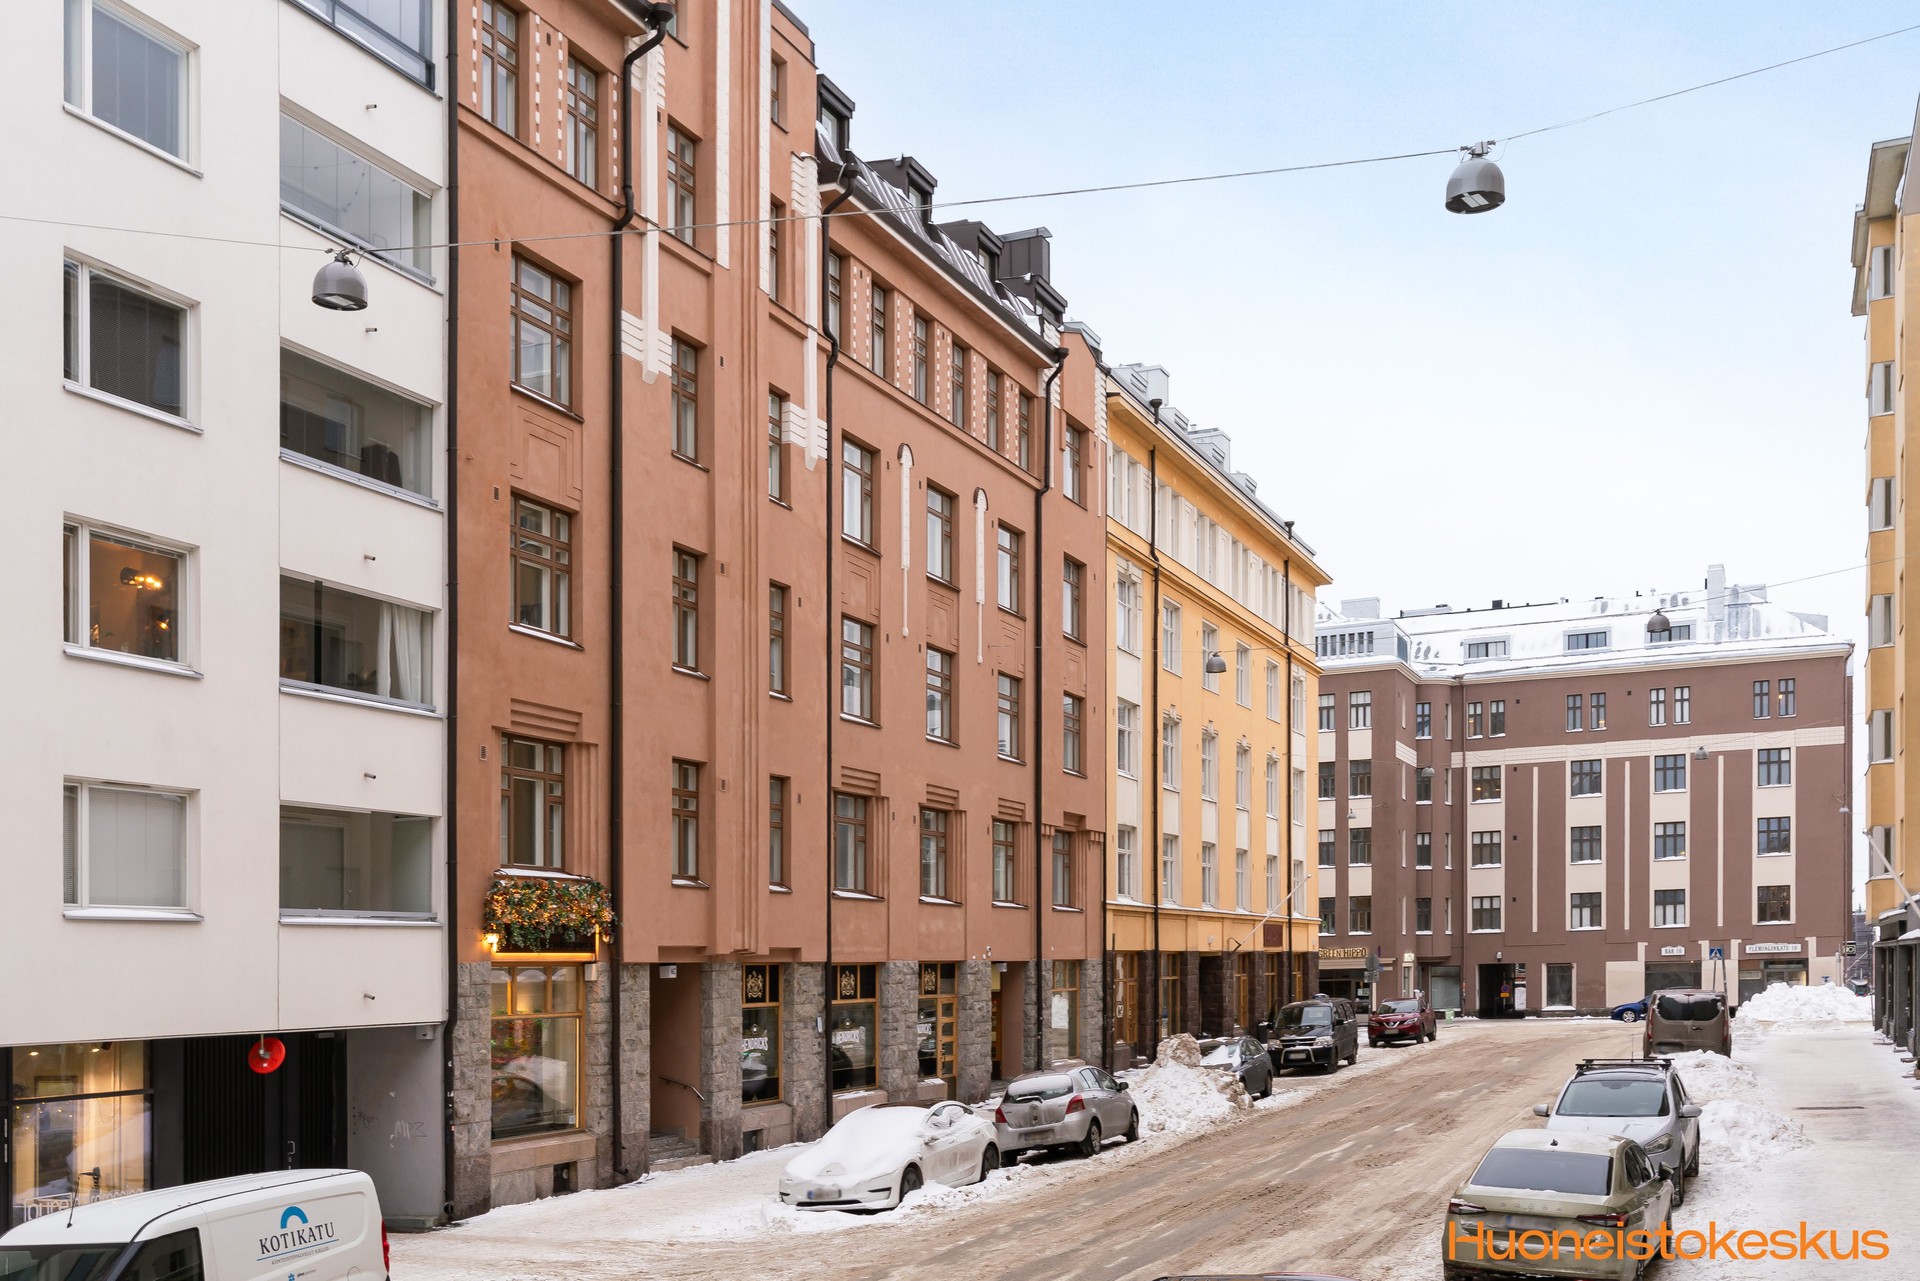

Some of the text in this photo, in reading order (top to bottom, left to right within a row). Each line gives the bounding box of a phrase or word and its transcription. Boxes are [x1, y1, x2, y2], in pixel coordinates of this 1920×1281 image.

[1319, 947, 1367, 958] GREEN HIPPO
[259, 1222, 335, 1255] KOTIKATU
